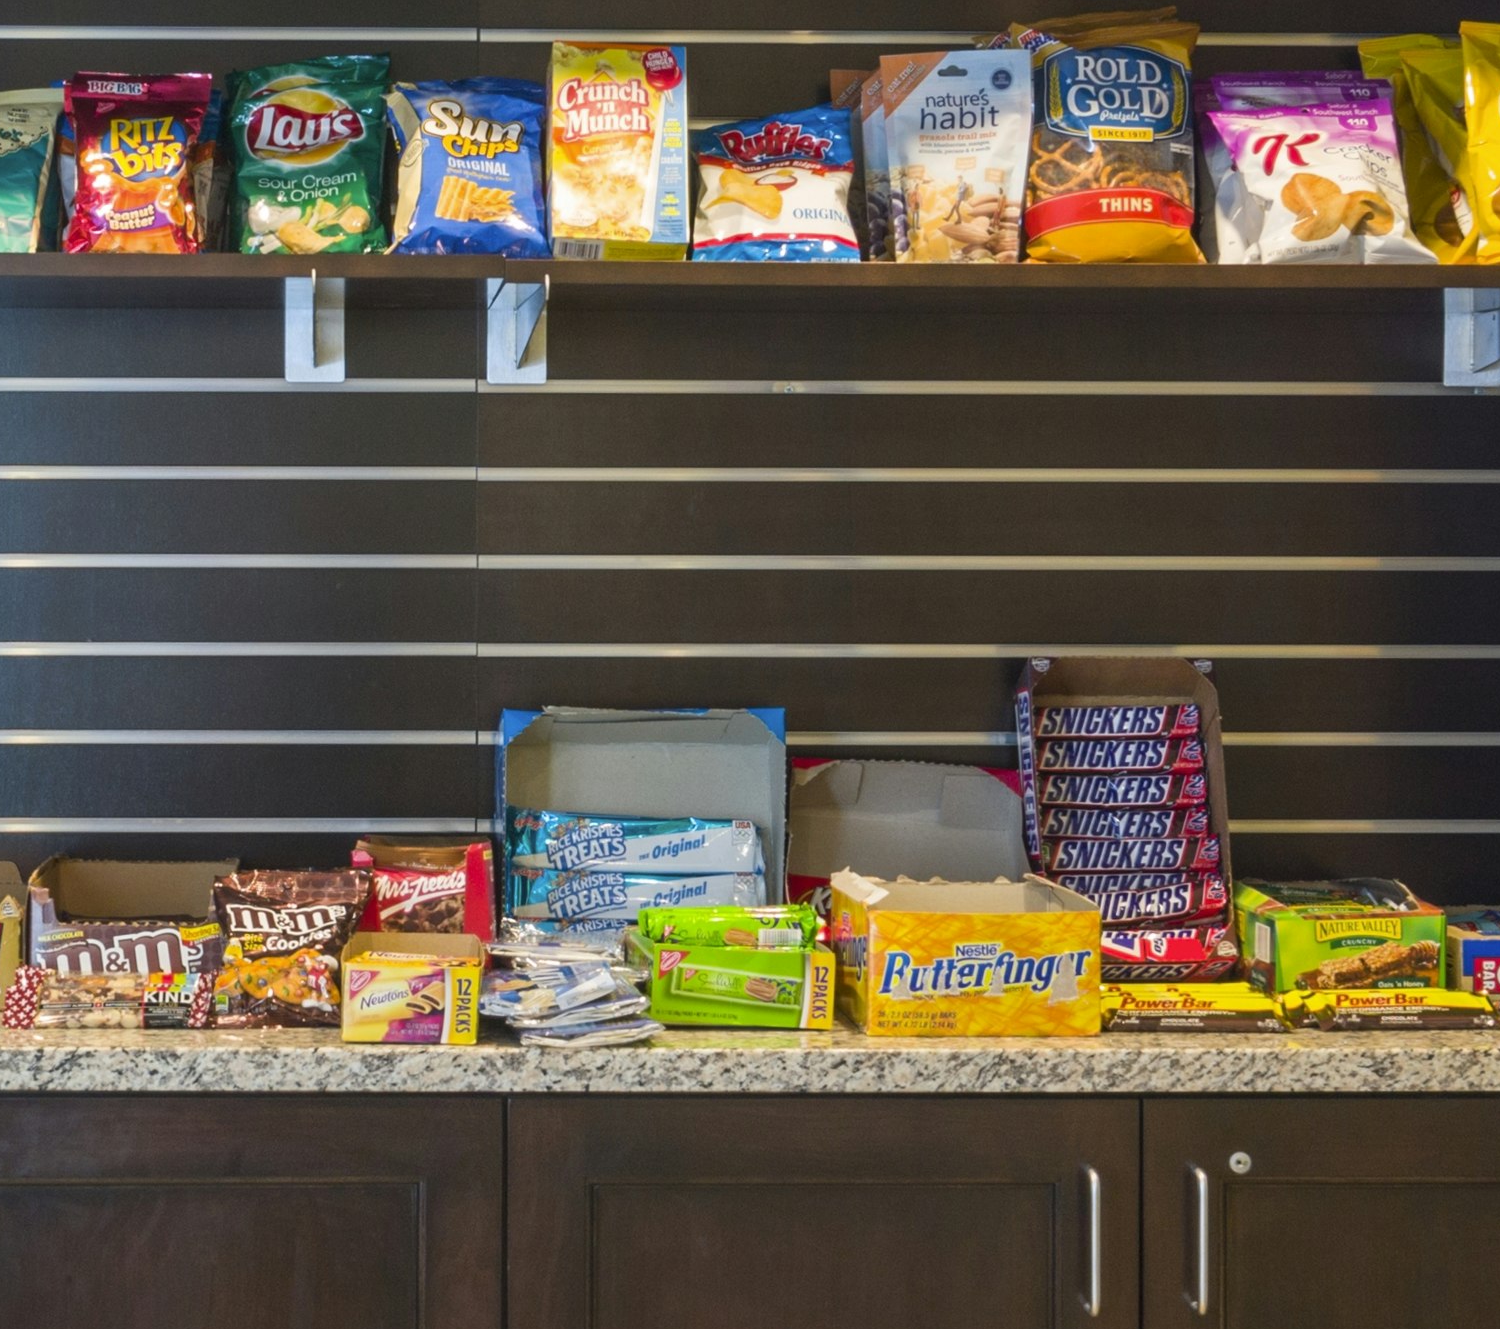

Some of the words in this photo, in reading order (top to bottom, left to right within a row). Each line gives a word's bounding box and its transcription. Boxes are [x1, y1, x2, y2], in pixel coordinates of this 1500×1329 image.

[1074, 55, 1162, 85] ROLD
[88, 81, 114, 93] BIG
[116, 83, 143, 95] BAG
[559, 81, 648, 111] Crunch
[925, 88, 990, 107] nature's
[1067, 85, 1170, 119] GOLD
[254, 107, 361, 151] Lay's
[423, 101, 522, 142] Sun
[566, 110, 649, 139] Munch
[920, 106, 999, 130] habit
[110, 116, 175, 150] RITZ
[721, 122, 833, 162] Ruffles
[1097, 130, 1124, 138] SINCE
[1127, 129, 1148, 137] 1917
[442, 135, 519, 159] Chips
[114, 142, 183, 177] bits
[448, 157, 510, 177] ORIGINAL
[258, 177, 297, 189] Sour
[302, 172, 357, 187] Cream
[278, 191, 288, 201] &
[290, 186, 339, 201] Onion
[1098, 197, 1153, 213] THINS
[105, 205, 155, 220] Peanut
[109, 216, 155, 230] Butter
[1041, 707, 1164, 735] SNICKERS
[1043, 741, 1166, 768] SNICKERS
[1018, 691, 1040, 854] SNICKERS
[1045, 776, 1170, 803] SNICKERS
[1046, 811, 1171, 837] SNICKERS
[549, 837, 572, 854] RICE
[573, 824, 623, 844] KRISPIES
[652, 835, 705, 859] Original
[551, 838, 626, 871] TREATS
[1057, 839, 1185, 870] SNICKERS
[548, 887, 572, 903] RICE
[573, 874, 623, 892] KRISPIES
[654, 882, 707, 907] Original
[551, 886, 627, 921] TREATS
[52, 931, 84, 941] CHOCOLATE
[244, 933, 262, 943] Bite
[266, 929, 332, 952] Cookies
[1319, 920, 1359, 939] NATURE
[1360, 919, 1399, 938] VALLEY
[243, 941, 263, 951] Size
[814, 966, 828, 981] 12
[1481, 960, 1496, 990] BAR
[145, 992, 194, 1004] KIND
[360, 988, 409, 1010] Newtons
[457, 979, 472, 995] 12
[812, 982, 827, 1019] PACKS
[1120, 997, 1216, 1009] PowerBar
[1336, 993, 1428, 1007] PowerBar
[456, 997, 471, 1033] PACKS
